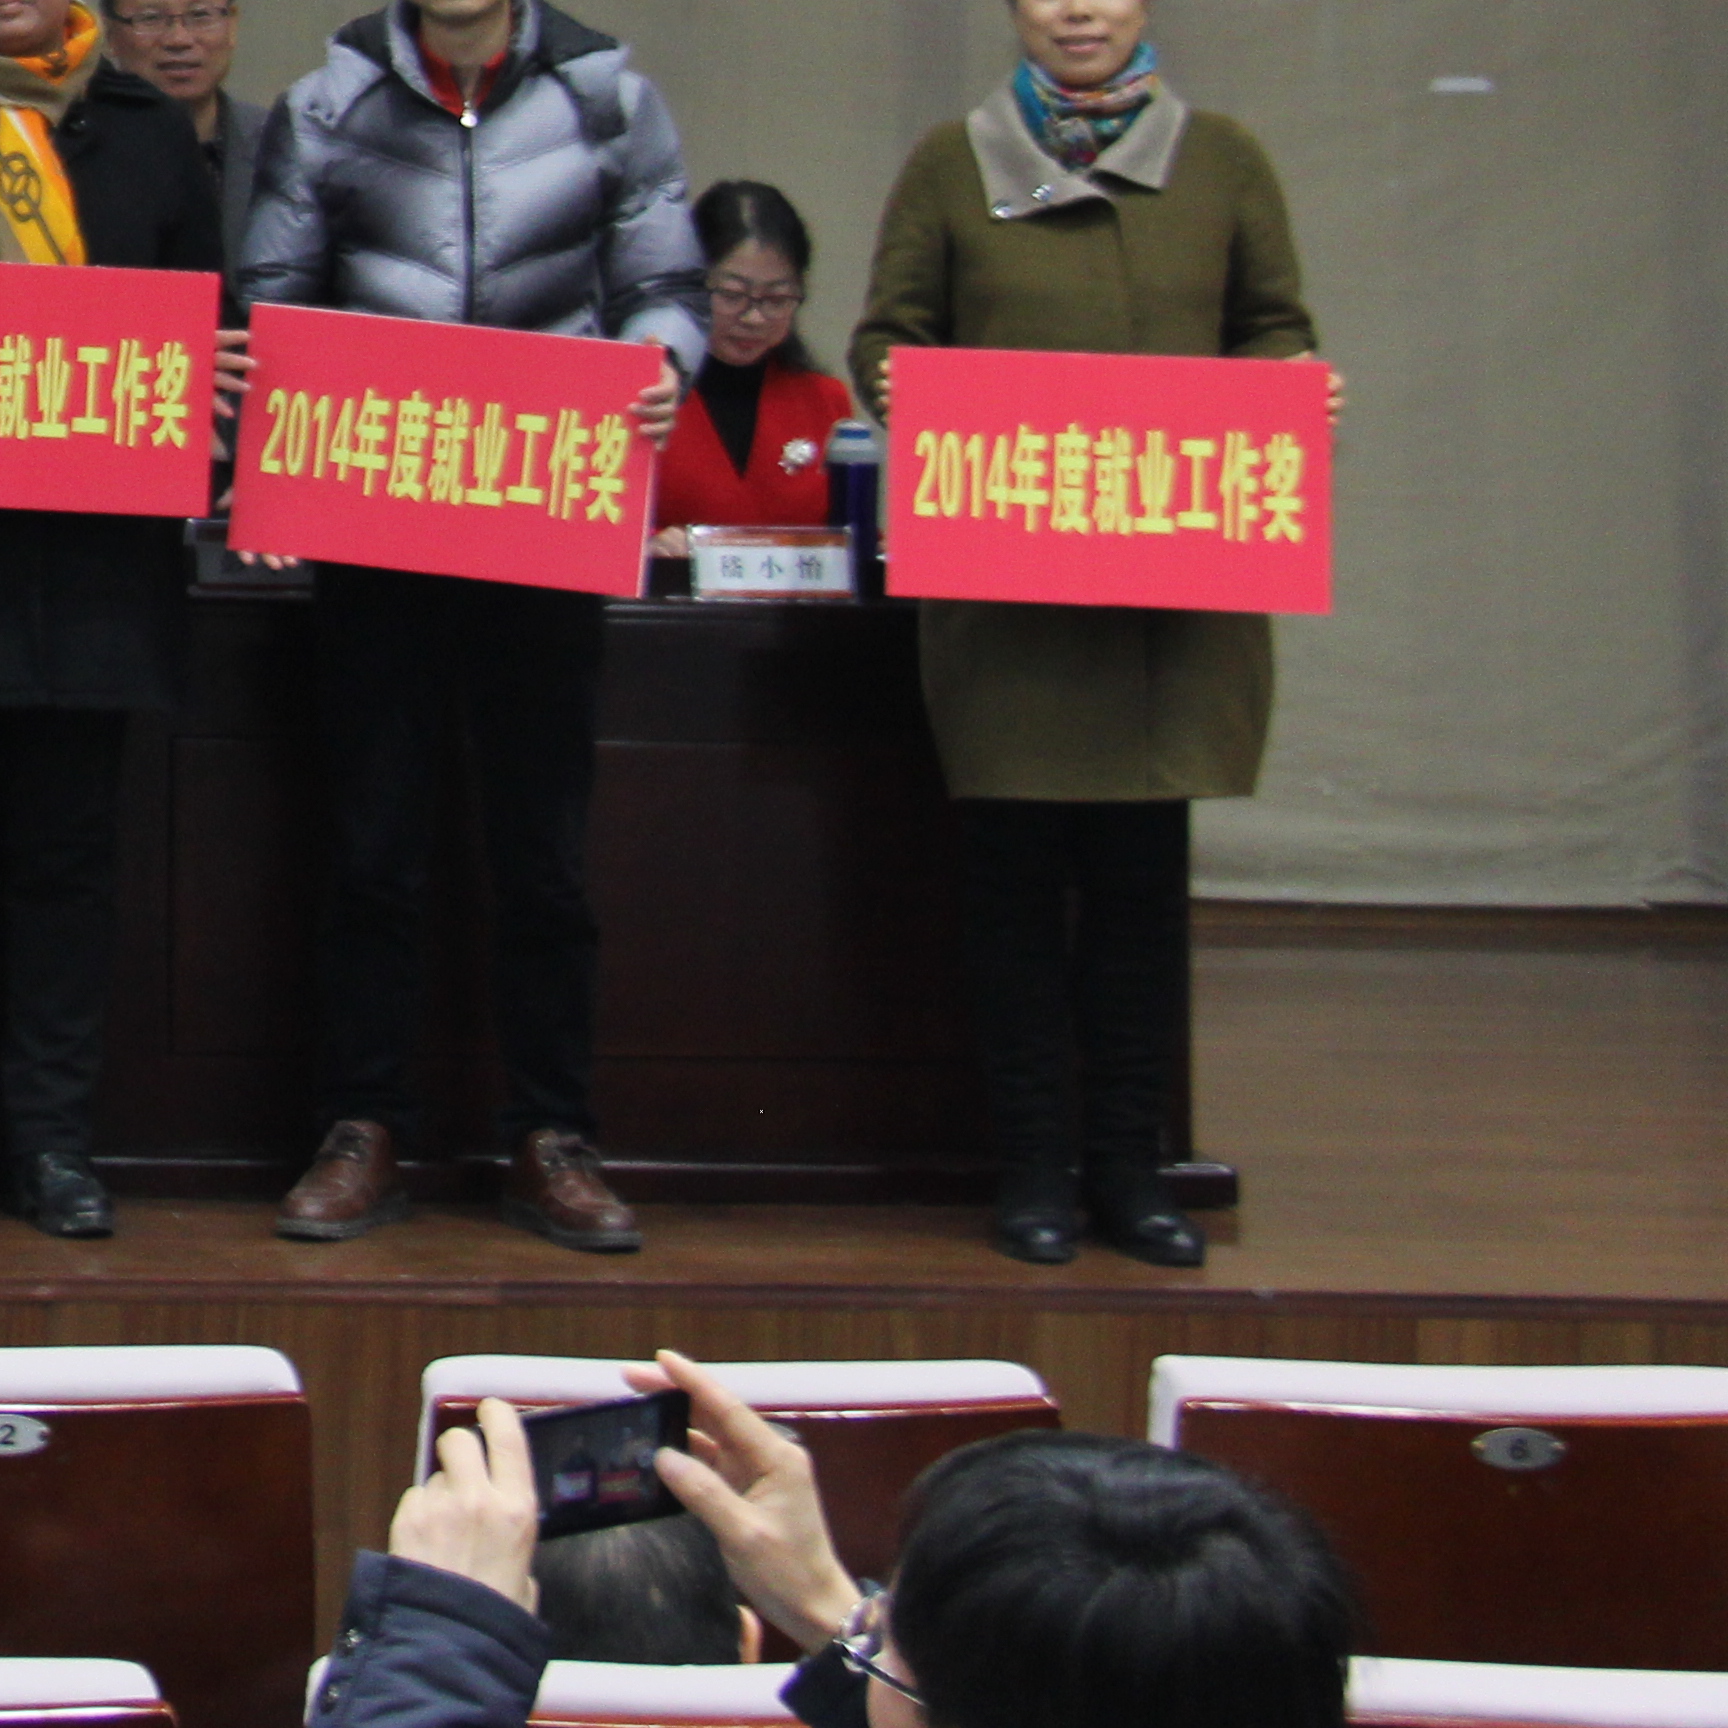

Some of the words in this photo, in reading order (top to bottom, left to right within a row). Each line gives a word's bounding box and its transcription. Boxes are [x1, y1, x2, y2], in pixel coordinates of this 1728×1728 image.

[259, 388, 630, 524] 2014年度就业工作奖
[913, 423, 1305, 543] 2014年度就业工作奖
